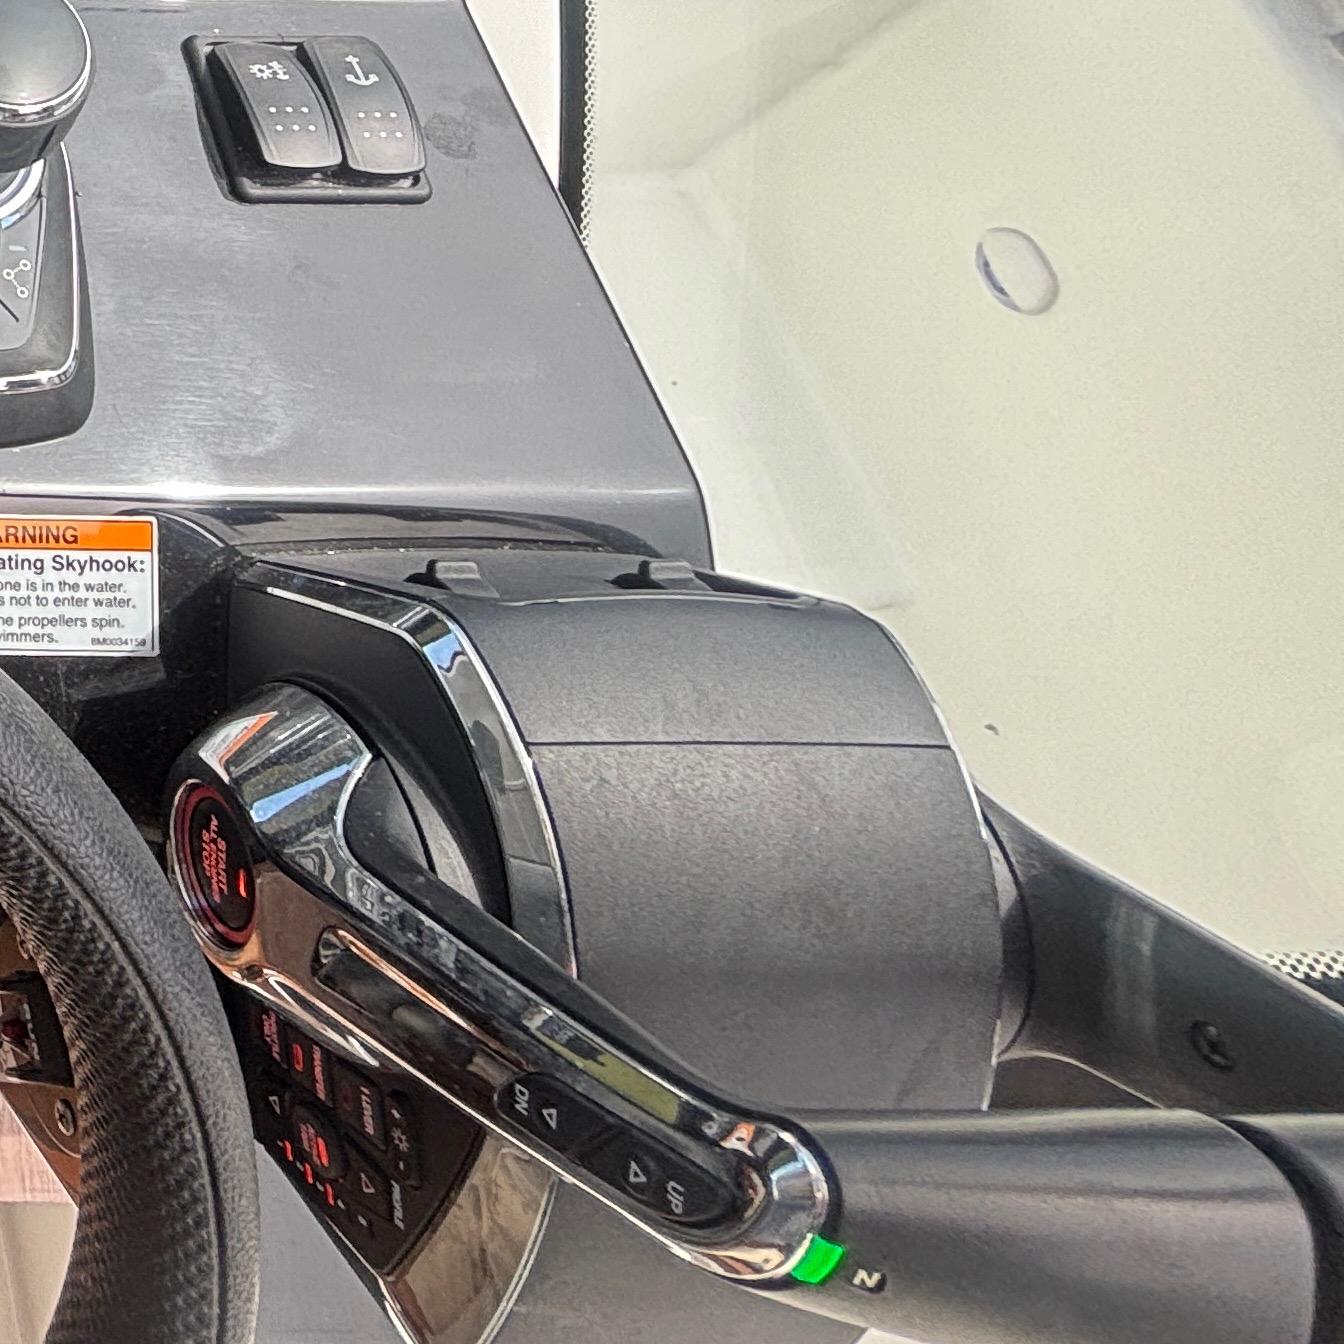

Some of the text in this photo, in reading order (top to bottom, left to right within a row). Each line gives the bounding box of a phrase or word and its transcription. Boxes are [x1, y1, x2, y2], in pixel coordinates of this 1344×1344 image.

[51, 554, 146, 577] Skyhook:
[26, 578, 38, 593] is
[41, 578, 55, 593] in
[58, 579, 80, 593] the
[84, 581, 127, 594] water.
[9, 594, 33, 607] not
[35, 595, 49, 608] to
[53, 595, 89, 608] enter
[92, 596, 136, 609] water.
[18, 614, 87, 630] propellers
[91, 615, 125, 632] spin.
[513, 1083, 530, 1116] DN
[664, 1180, 686, 1216] UP
[852, 1268, 883, 1290] N
